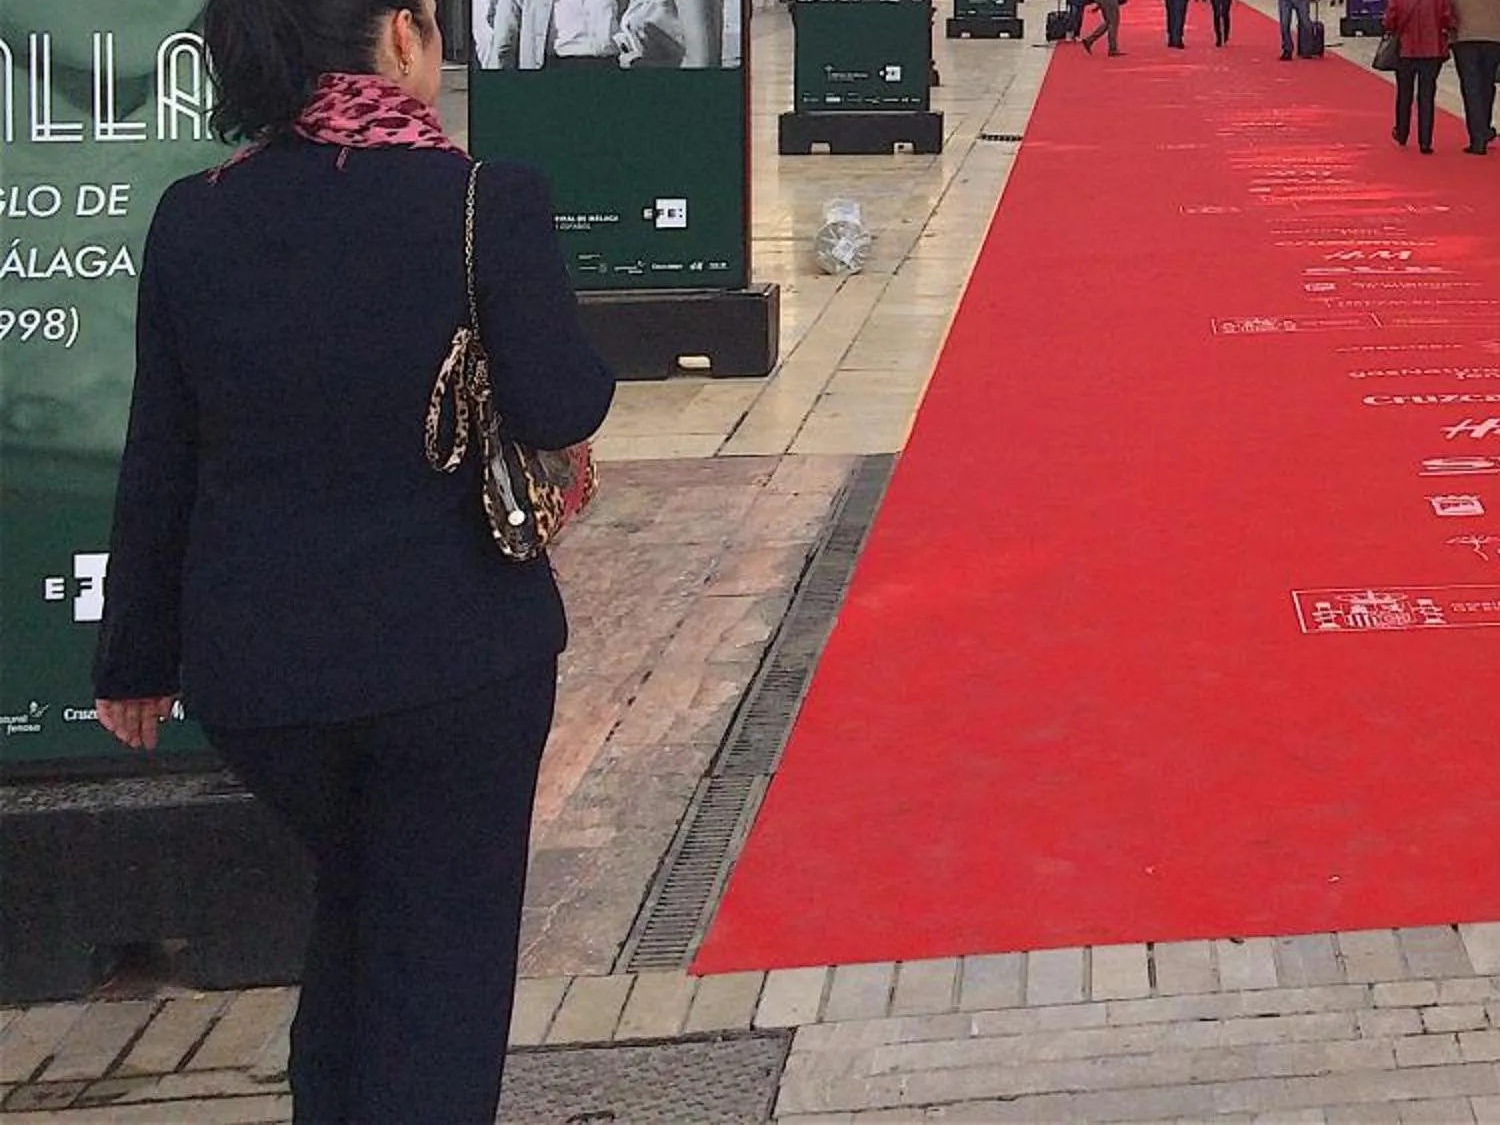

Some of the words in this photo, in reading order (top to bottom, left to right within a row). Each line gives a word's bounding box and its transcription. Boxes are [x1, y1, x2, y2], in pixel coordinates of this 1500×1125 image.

[0, 31, 213, 143] LLA
[0, 184, 61, 217] LO
[76, 184, 131, 217] DE
[63, 708, 100, 722] Cruz
